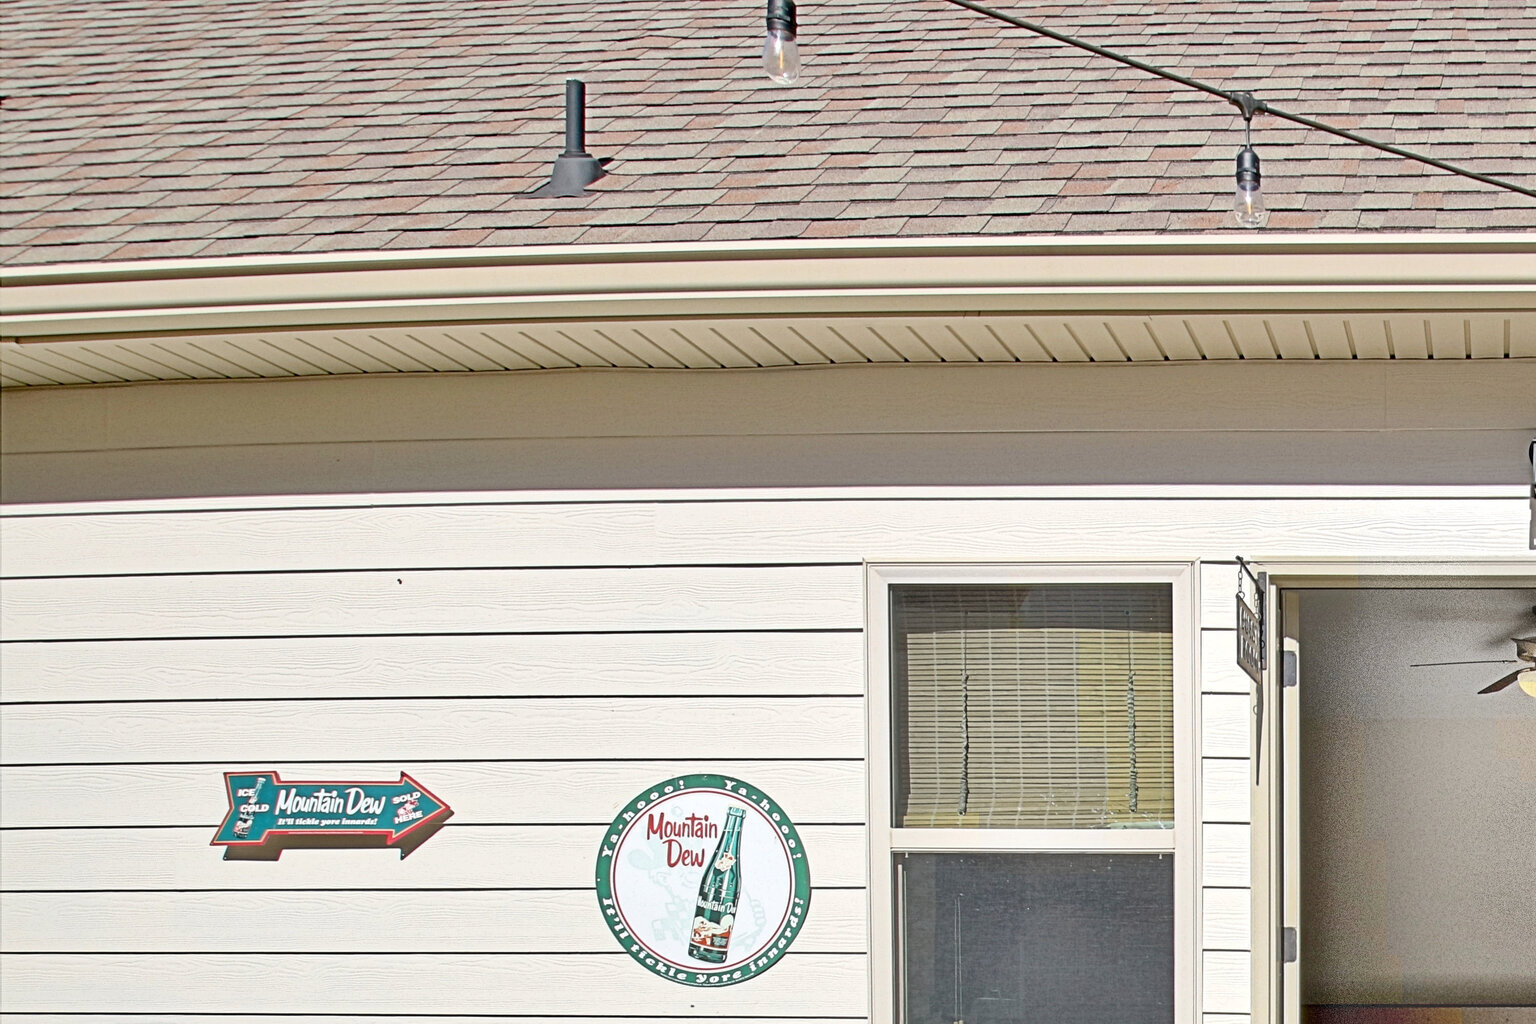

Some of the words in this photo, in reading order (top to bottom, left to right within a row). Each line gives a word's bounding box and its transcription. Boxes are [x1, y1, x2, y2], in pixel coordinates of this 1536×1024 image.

[237, 788, 256, 797] ICE
[392, 791, 421, 805] SOLD
[240, 803, 270, 813] COLD
[275, 787, 345, 816] Mountain
[346, 787, 386, 815] Dew
[276, 817, 294, 826] It'll
[295, 817, 320, 826] tickle
[320, 818, 341, 827] yore
[341, 817, 378, 826] innards!
[394, 811, 424, 824] HERE
[646, 812, 718, 841] Mountain
[662, 839, 705, 868] Dew
[602, 897, 628, 940] It'll
[630, 942, 687, 981] tickle
[696, 971, 743, 984] yore
[749, 897, 804, 973] innards!
